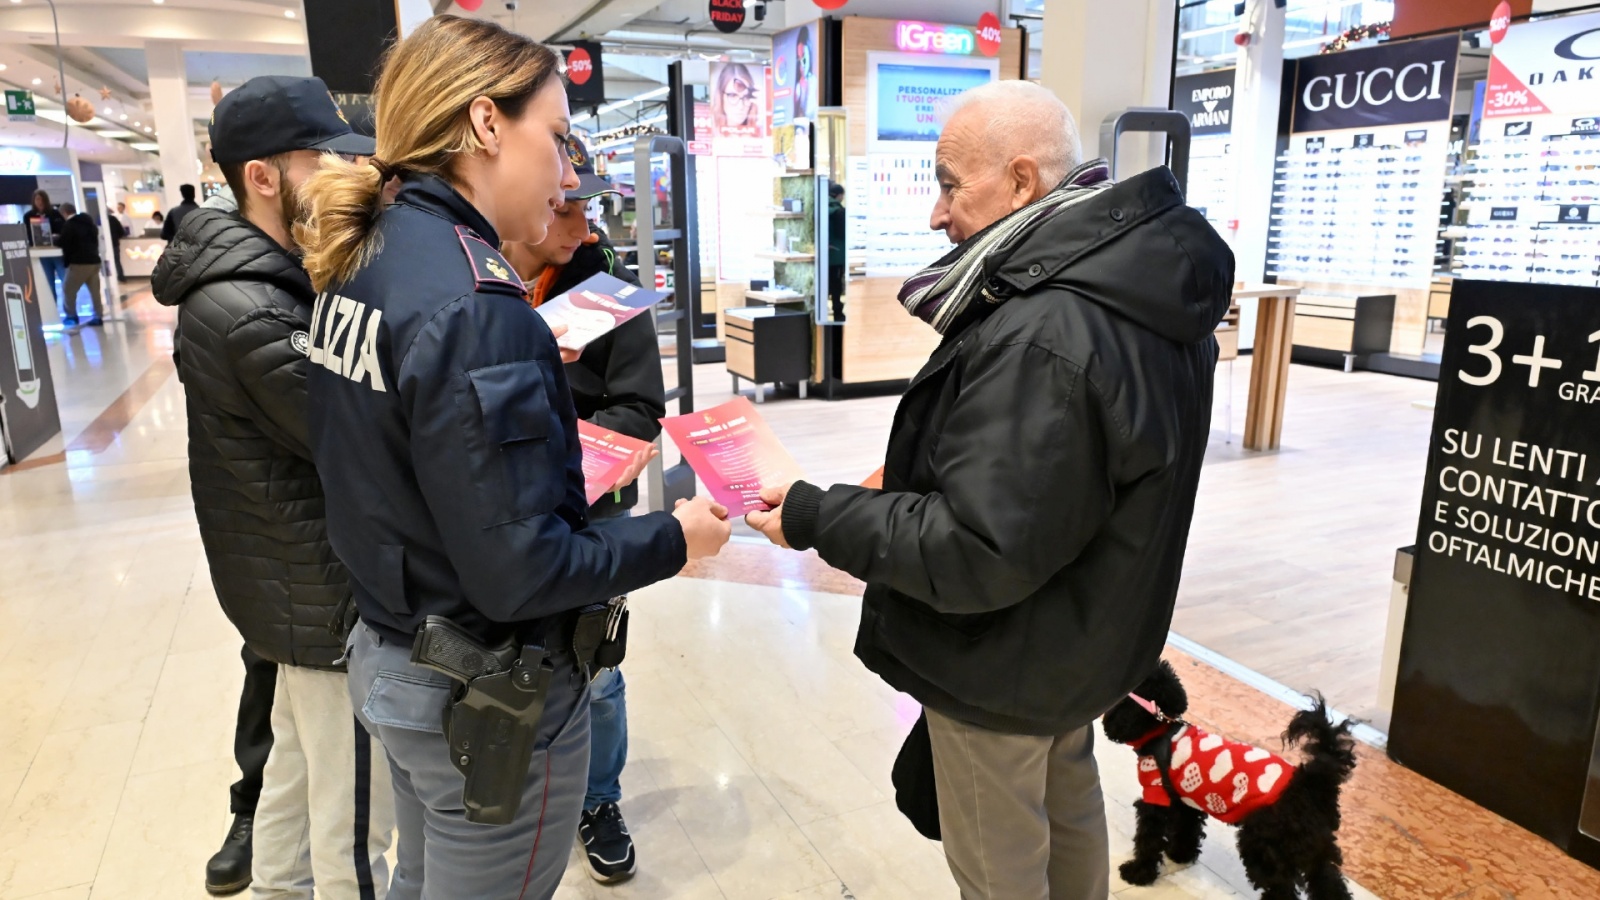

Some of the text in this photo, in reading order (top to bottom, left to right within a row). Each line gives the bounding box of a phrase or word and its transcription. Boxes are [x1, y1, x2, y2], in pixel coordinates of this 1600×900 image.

[711, 10, 744, 22] FRIDAY
[976, 26, 1001, 43] -40%
[567, 59, 592, 72] -50%
[898, 85, 966, 96] PERSONALIZZ
[1191, 85, 1232, 103] EMPORIO
[1302, 60, 1446, 112] GUCCI
[902, 95, 924, 104] TUOI
[1488, 89, 1528, 108] -30%
[1191, 109, 1230, 128] ARMANI
[307, 292, 387, 392] LIZIA
[1442, 428, 1587, 482] SU LENTI
[1439, 466, 1600, 530] CONTATTO
[1435, 500, 1449, 524] E
[1428, 531, 1600, 602] OFTALMICHE
